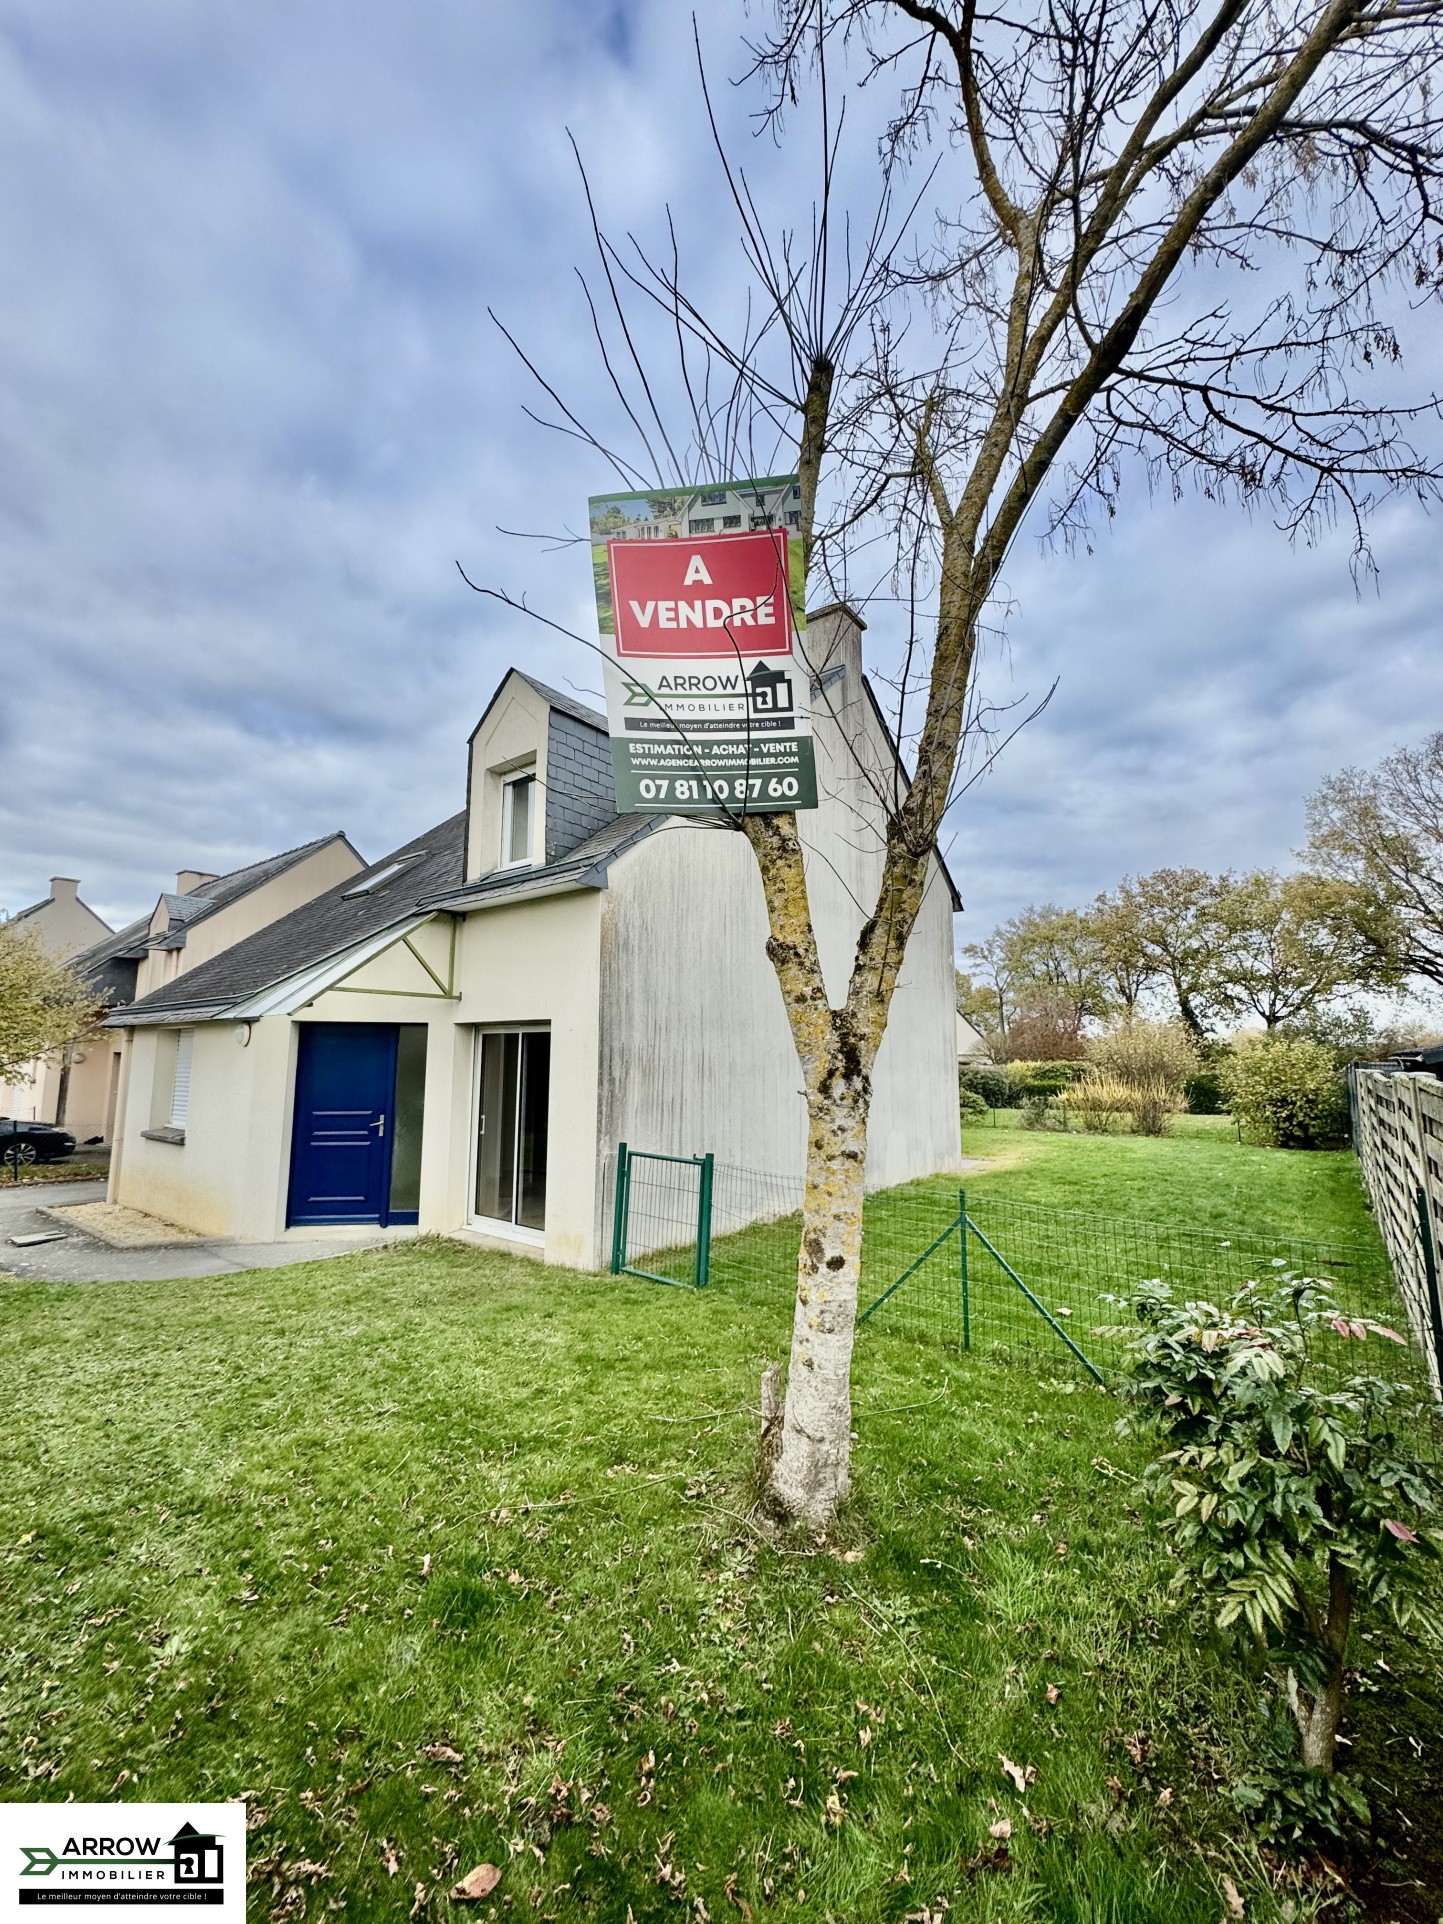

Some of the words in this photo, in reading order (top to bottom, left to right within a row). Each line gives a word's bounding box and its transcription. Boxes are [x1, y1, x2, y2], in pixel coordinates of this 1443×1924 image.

[683, 554, 713, 586] A
[629, 596, 776, 629] VENDRE
[657, 675, 739, 691] ARROW
[659, 703, 745, 711] MMOBILIER
[629, 743, 702, 755] ESTIMATION
[760, 742, 798, 753] VENTE
[639, 779, 670, 799] 07
[675, 779, 699, 799] 81
[703, 779, 729, 799] 10
[734, 779, 763, 799] 87
[768, 776, 799, 797] 60
